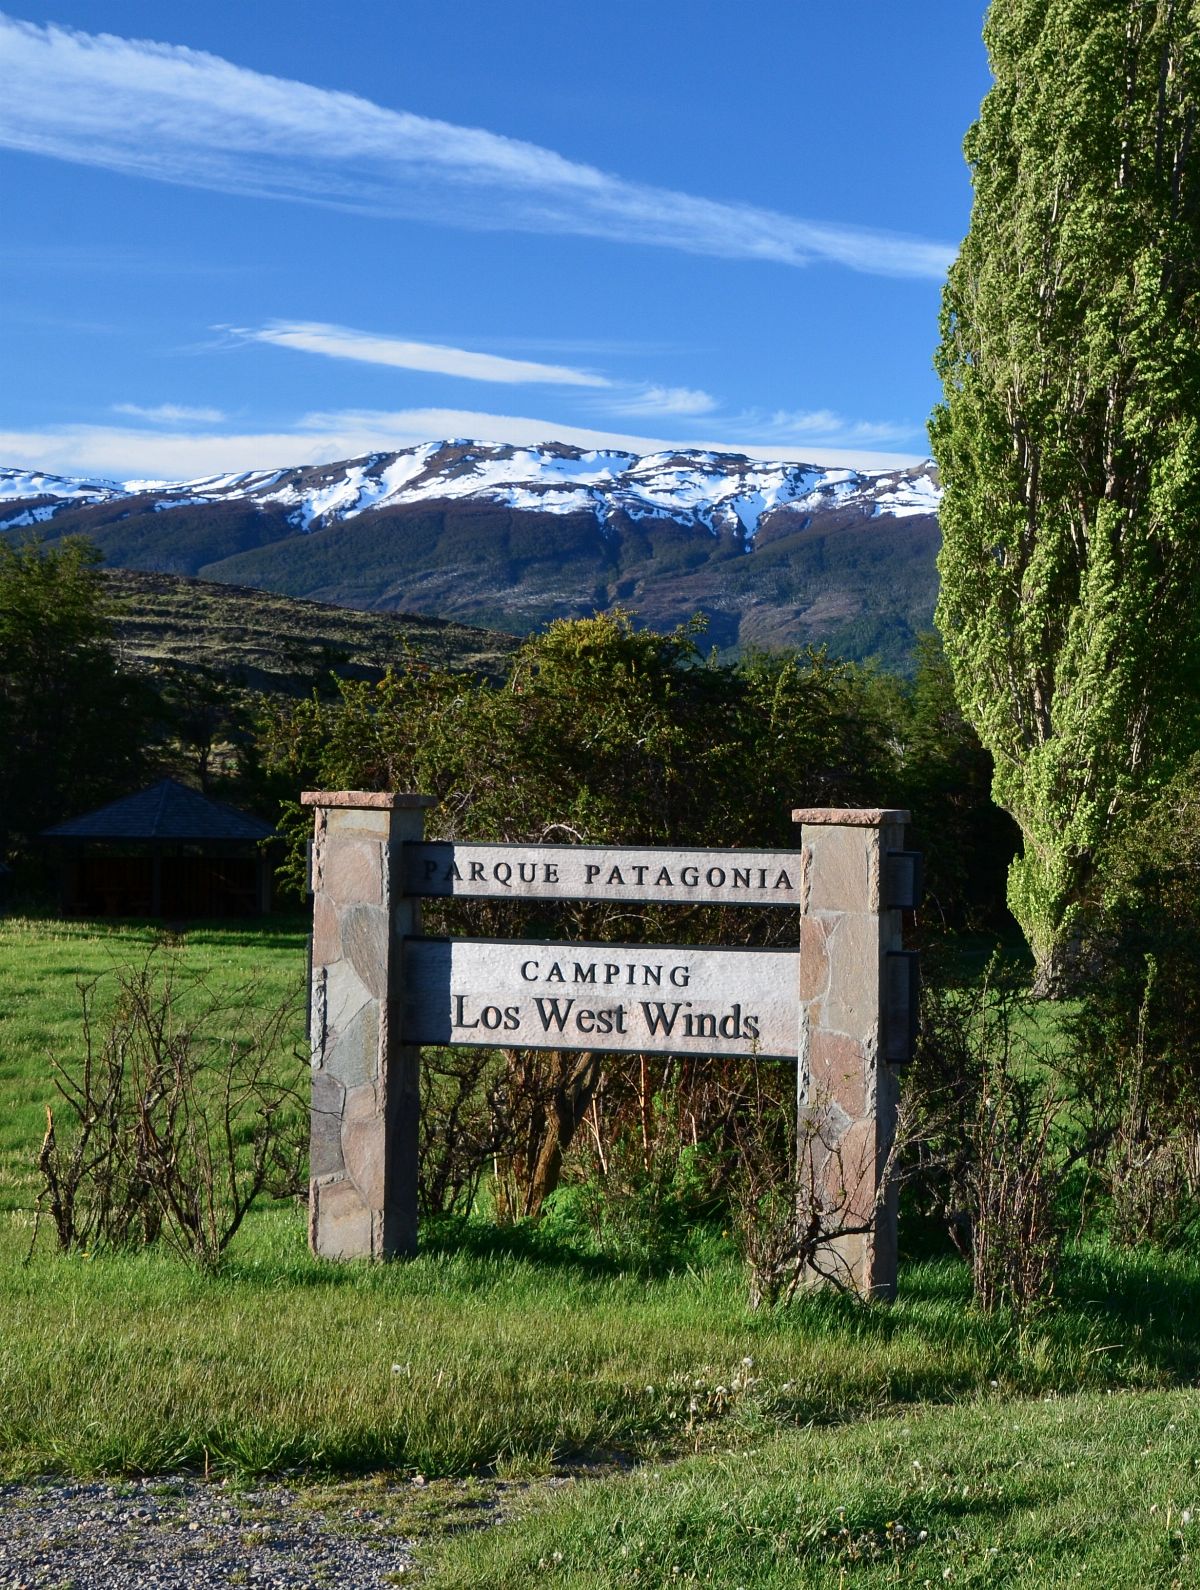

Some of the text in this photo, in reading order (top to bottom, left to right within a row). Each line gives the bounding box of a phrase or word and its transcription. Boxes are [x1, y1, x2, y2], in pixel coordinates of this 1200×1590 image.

[424, 860, 794, 890] PARQUE PATAGONIA
[520, 960, 691, 988] CAMPING
[452, 994, 760, 1040] Los West Winds
